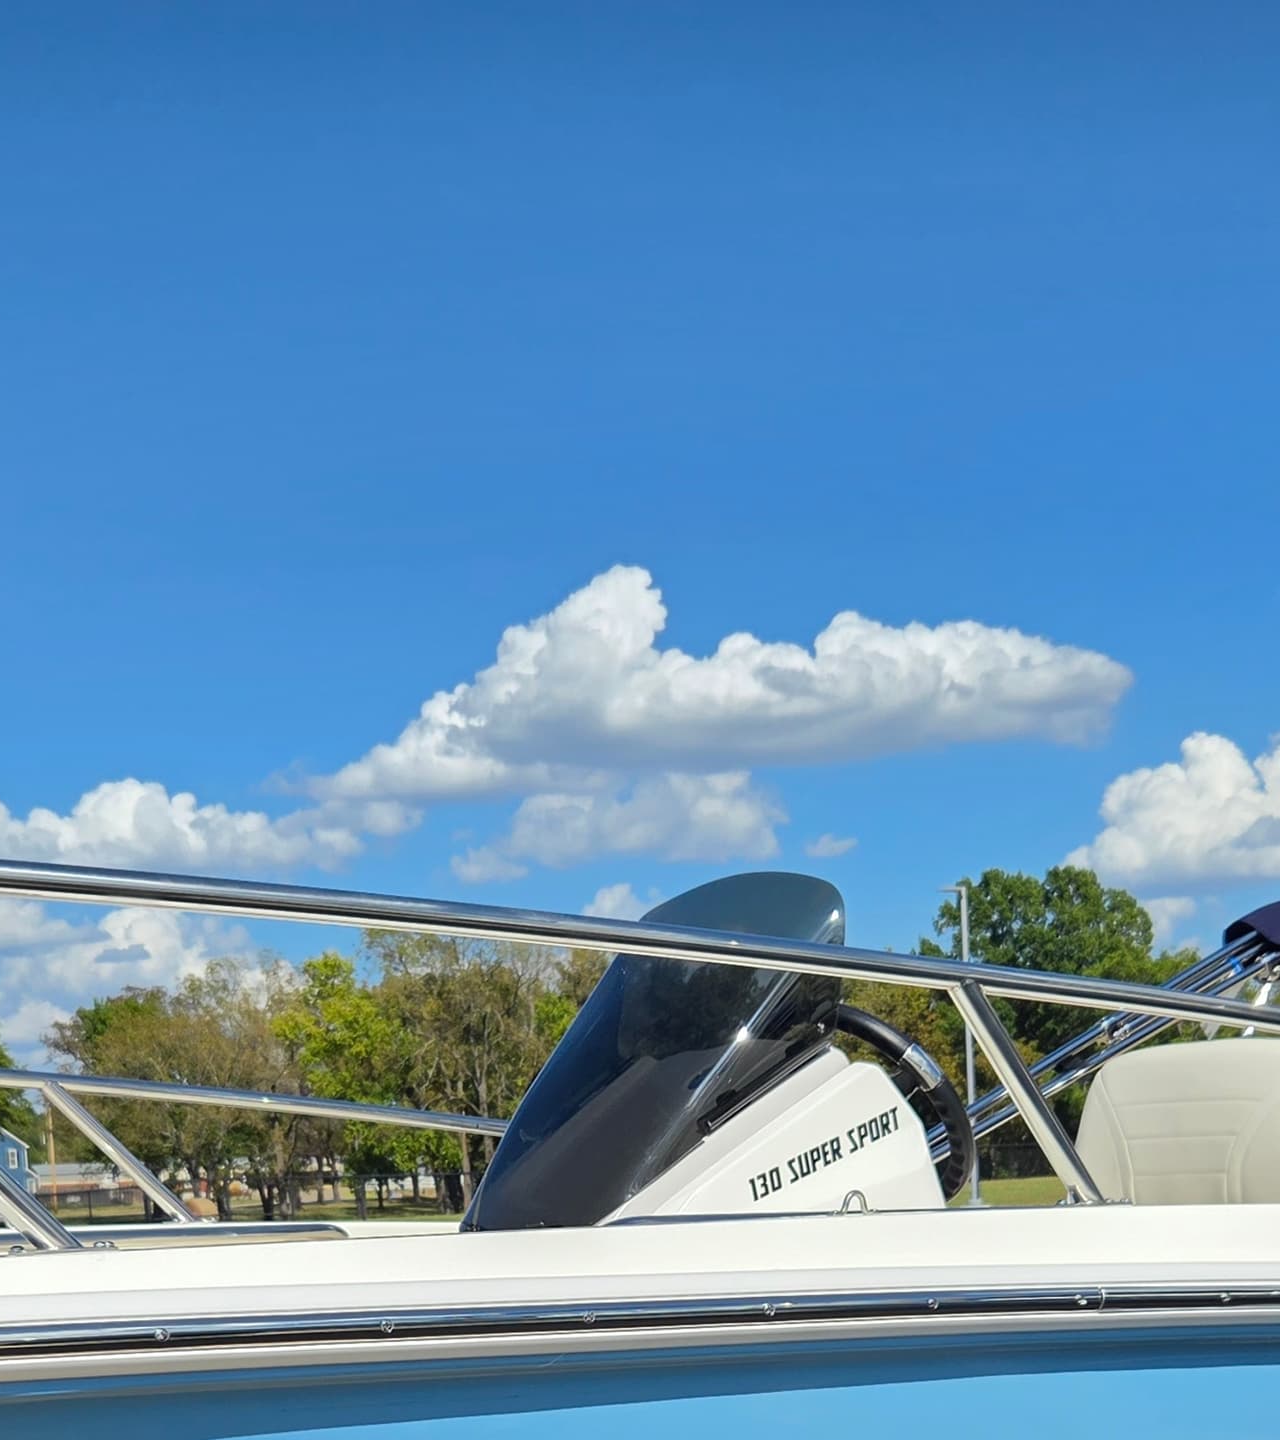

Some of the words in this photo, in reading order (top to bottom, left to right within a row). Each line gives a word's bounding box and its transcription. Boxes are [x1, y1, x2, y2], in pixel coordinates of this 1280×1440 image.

[748, 1166, 782, 1202] 130
[787, 1136, 843, 1184] SUPER
[846, 1106, 900, 1154] SPORT
